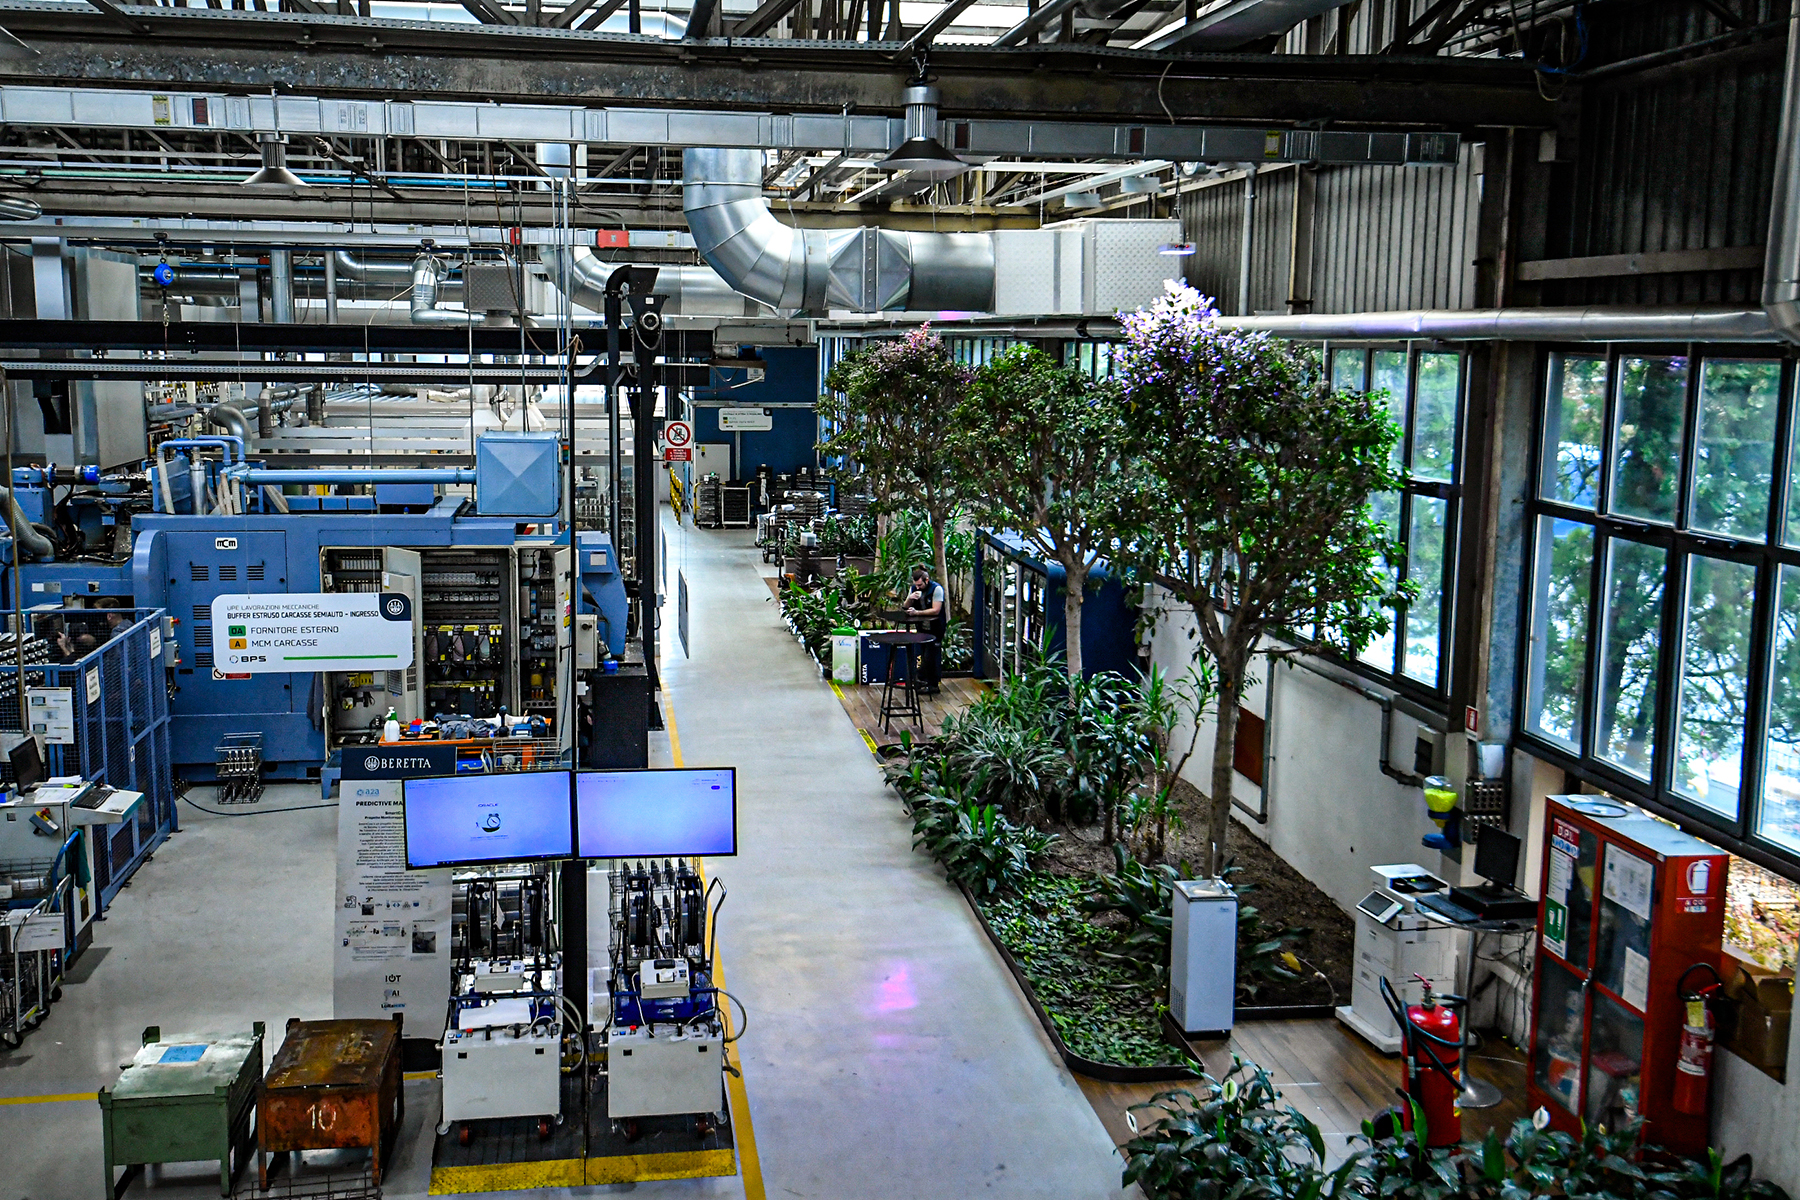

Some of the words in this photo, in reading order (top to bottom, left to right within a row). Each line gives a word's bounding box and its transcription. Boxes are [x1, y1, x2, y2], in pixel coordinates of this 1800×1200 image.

[281, 611, 311, 619] CARCASSE
[350, 610, 379, 618] INGRESSO
[251, 626, 298, 634] FORNITORE
[301, 626, 339, 634] ESTERNO
[274, 639, 318, 647] CARCASSE
[241, 655, 267, 663] BPS
[381, 757, 432, 769] BERETTA
